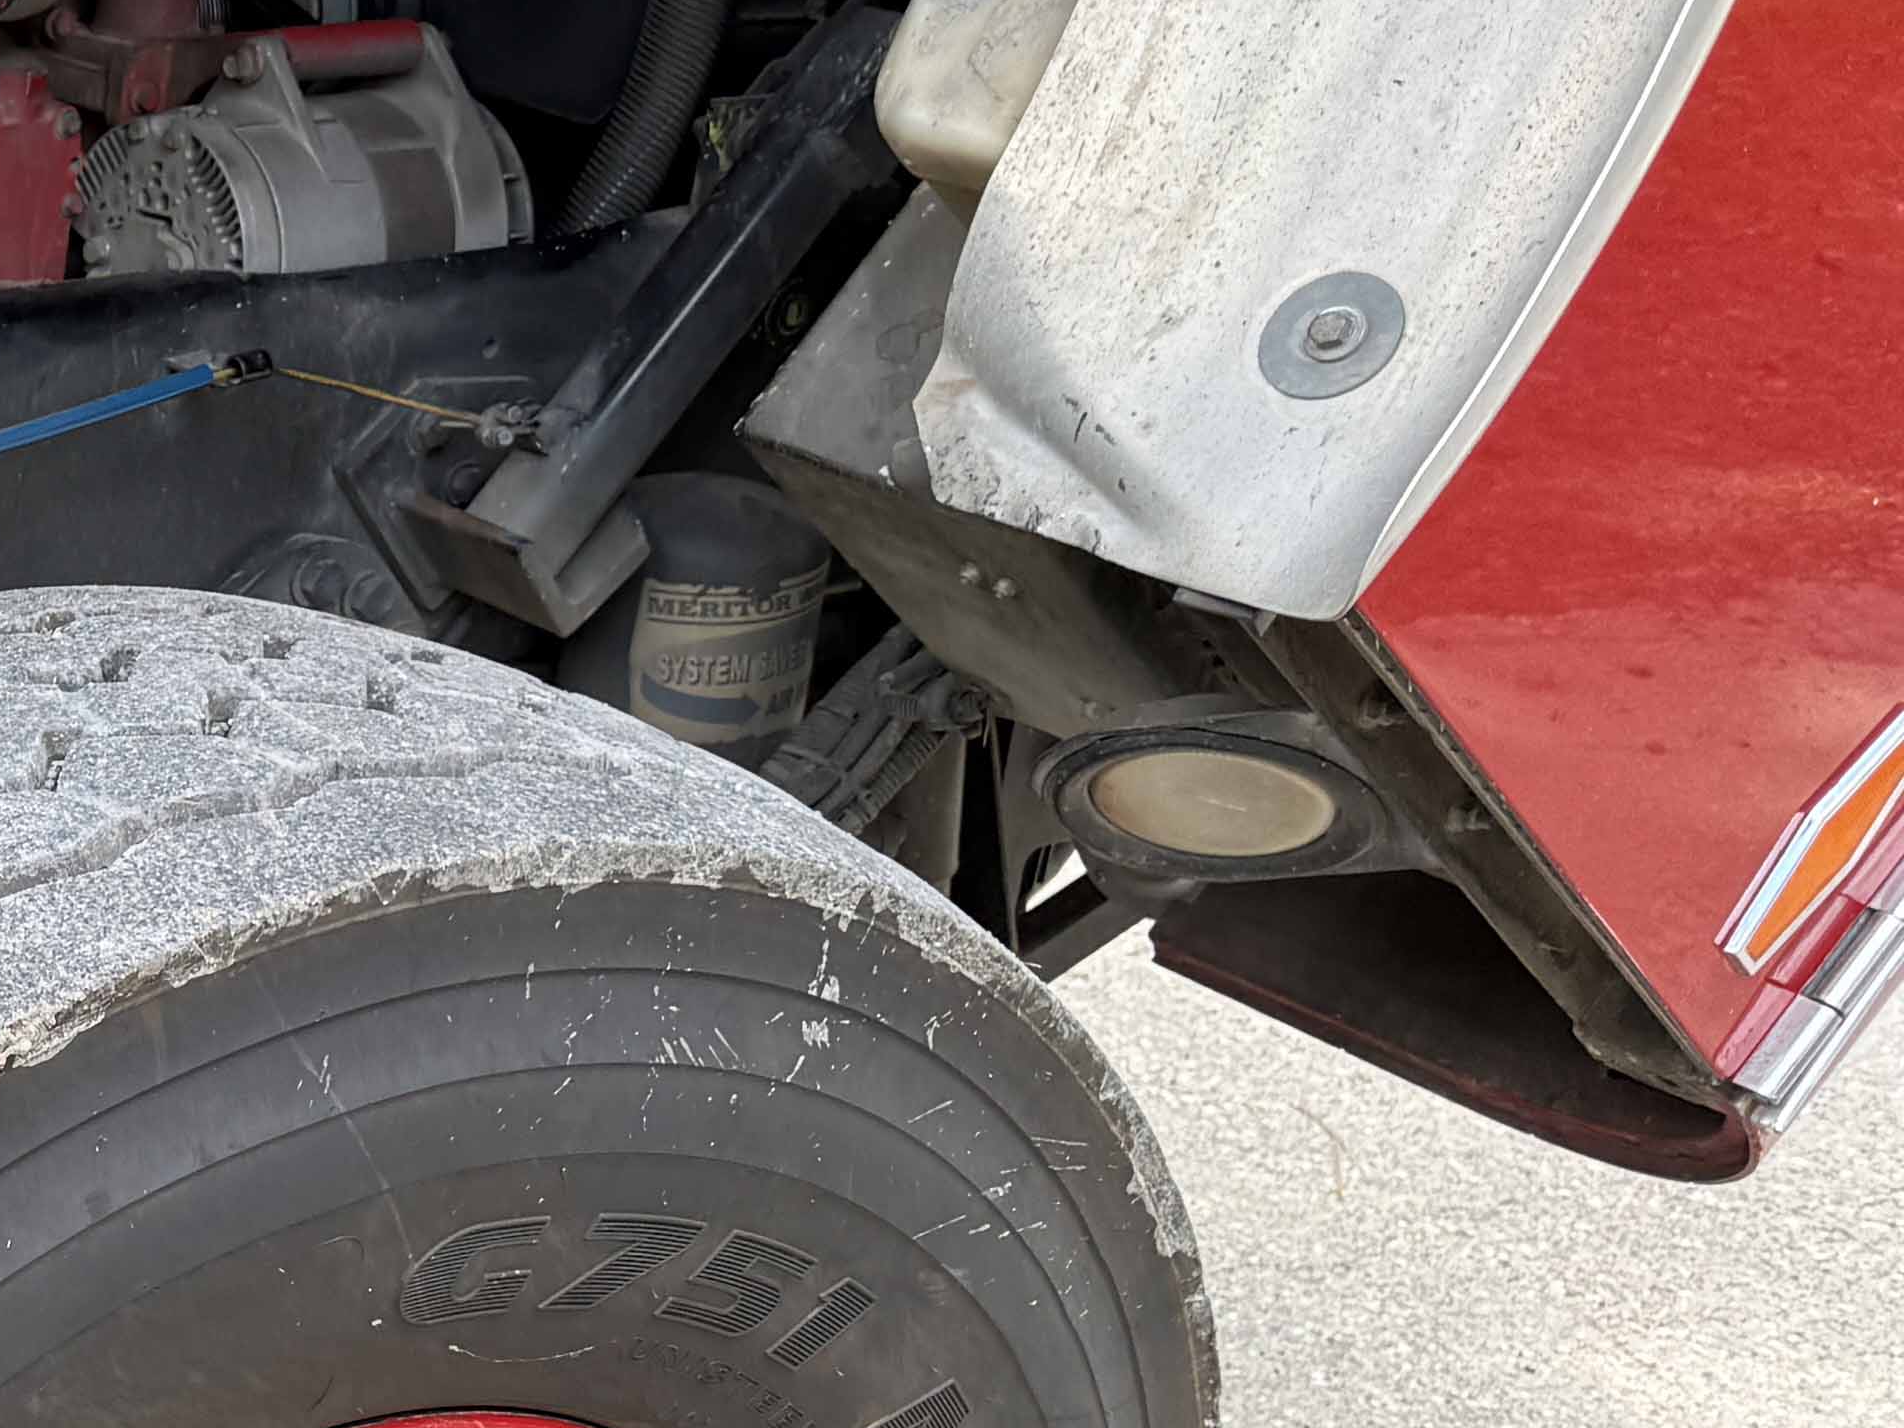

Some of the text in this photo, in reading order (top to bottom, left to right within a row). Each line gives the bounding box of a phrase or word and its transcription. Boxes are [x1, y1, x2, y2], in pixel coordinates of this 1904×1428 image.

[648, 594, 792, 618] MERITOR
[657, 653, 752, 686] SYSTEM
[399, 1212, 879, 1370] G751
